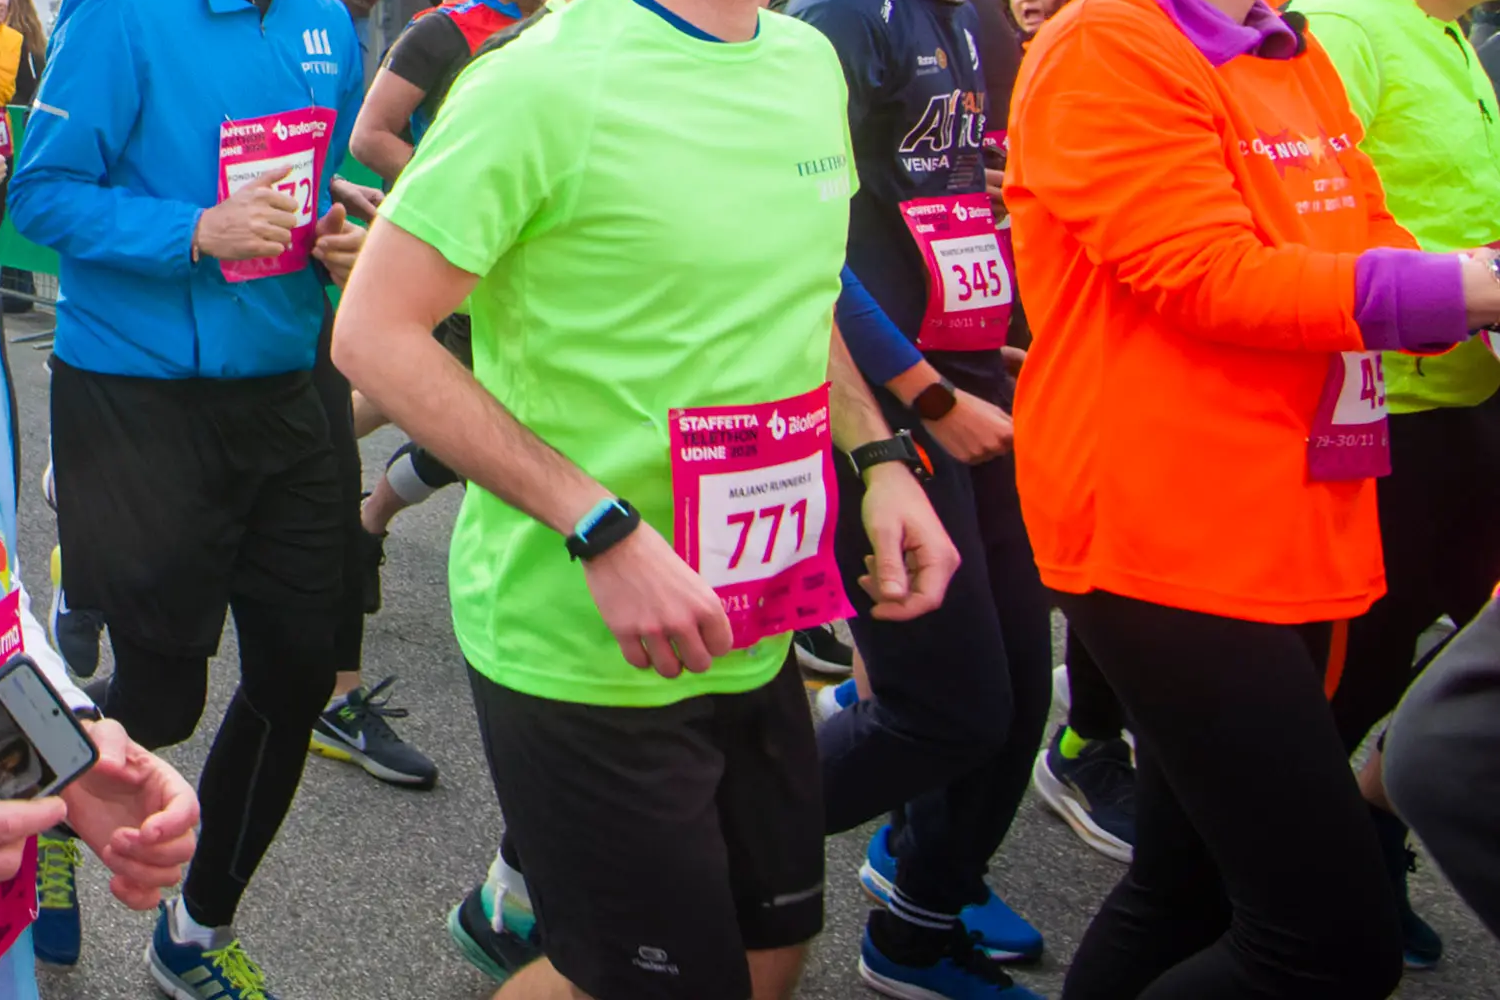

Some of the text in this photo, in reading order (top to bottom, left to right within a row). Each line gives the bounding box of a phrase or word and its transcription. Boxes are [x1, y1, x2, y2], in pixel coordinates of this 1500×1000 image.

[952, 260, 1002, 301] 345
[679, 414, 759, 432] STAFFETTA
[681, 430, 757, 446] TELETHON
[681, 446, 726, 461] UDINE
[727, 498, 807, 570] 771
